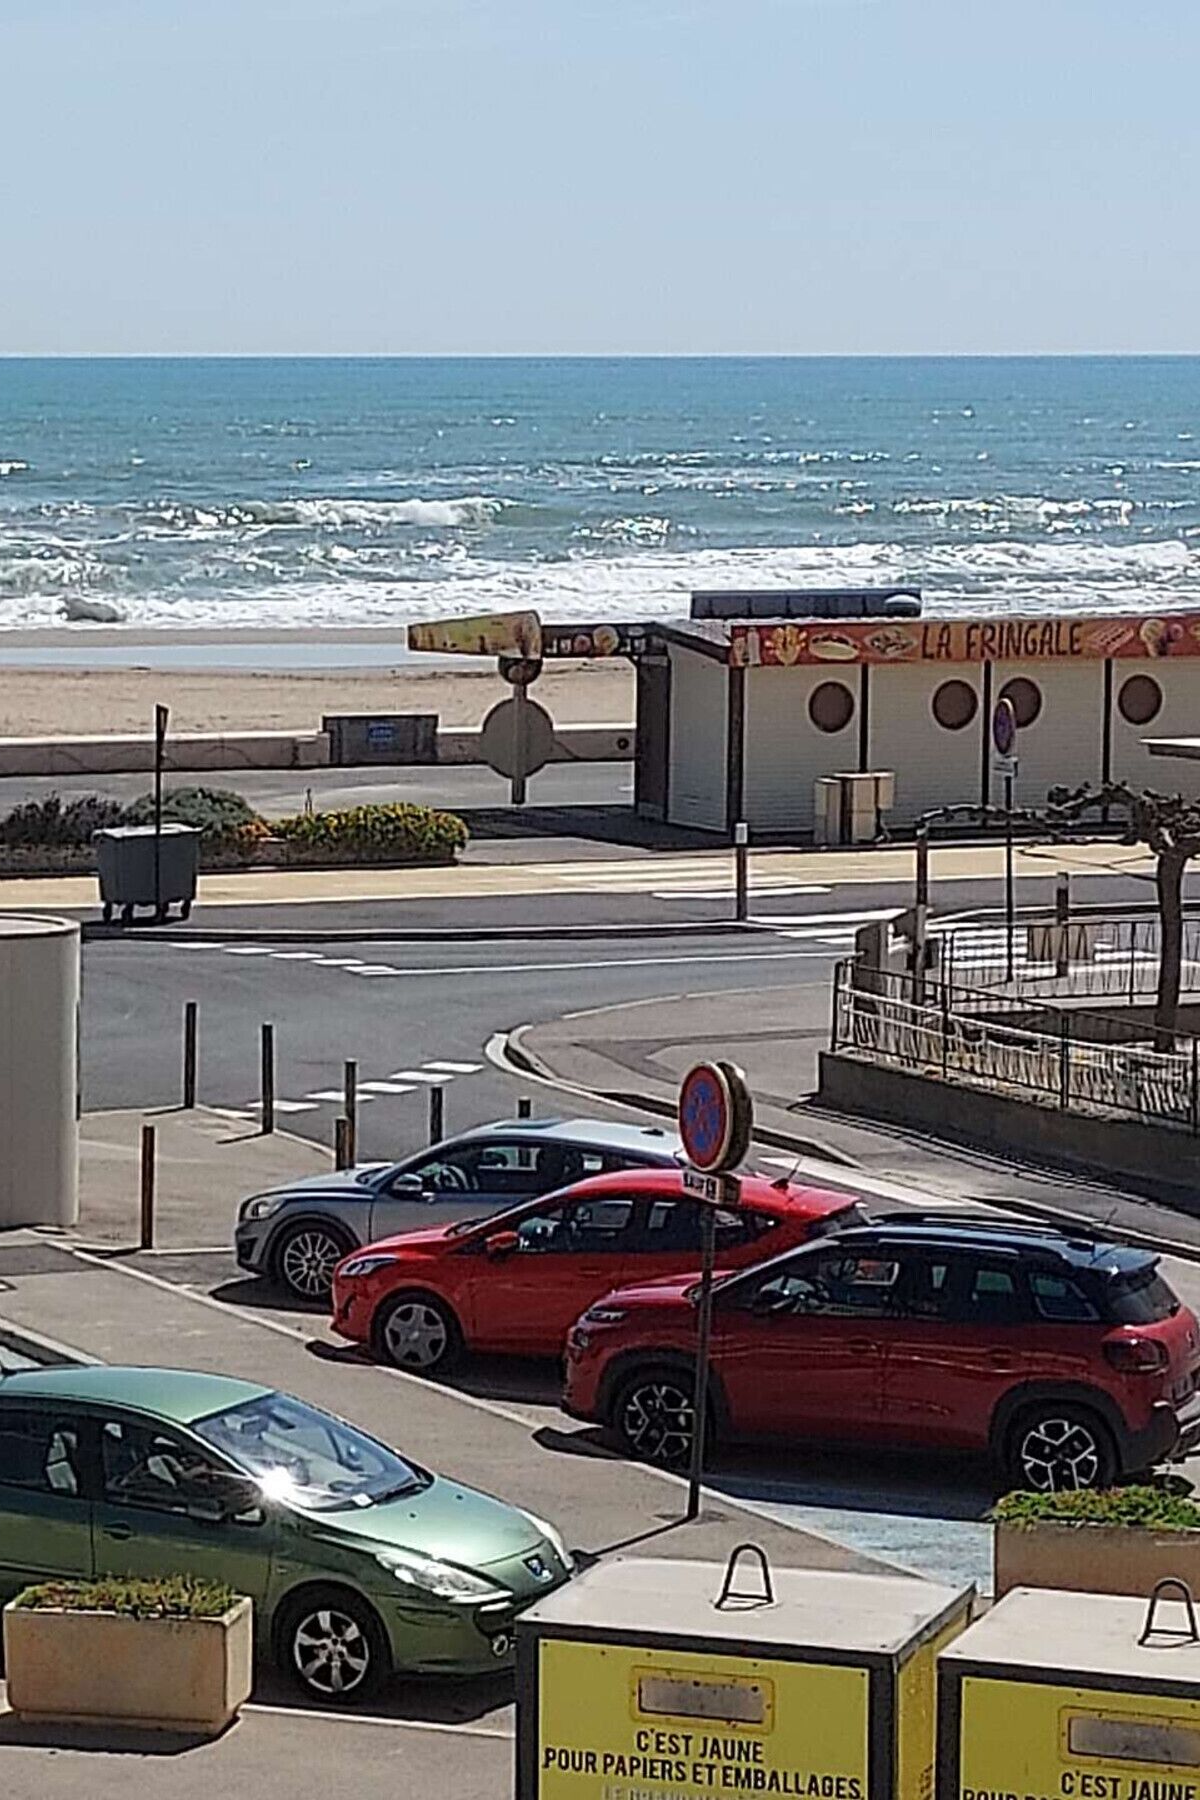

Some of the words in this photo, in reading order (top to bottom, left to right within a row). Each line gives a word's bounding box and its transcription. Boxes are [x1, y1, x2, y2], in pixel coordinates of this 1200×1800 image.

[921, 624, 950, 659] LA
[966, 621, 1083, 659] FRINGALE
[636, 1729, 693, 1756] C'EST
[699, 1737, 764, 1763] JAUNE
[542, 1747, 597, 1773] POUR
[603, 1753, 687, 1782] PAPIERS
[692, 1763, 717, 1786] ET
[1061, 1770, 1121, 1799] C'EST
[1128, 1779, 1197, 1800] JAUNE
